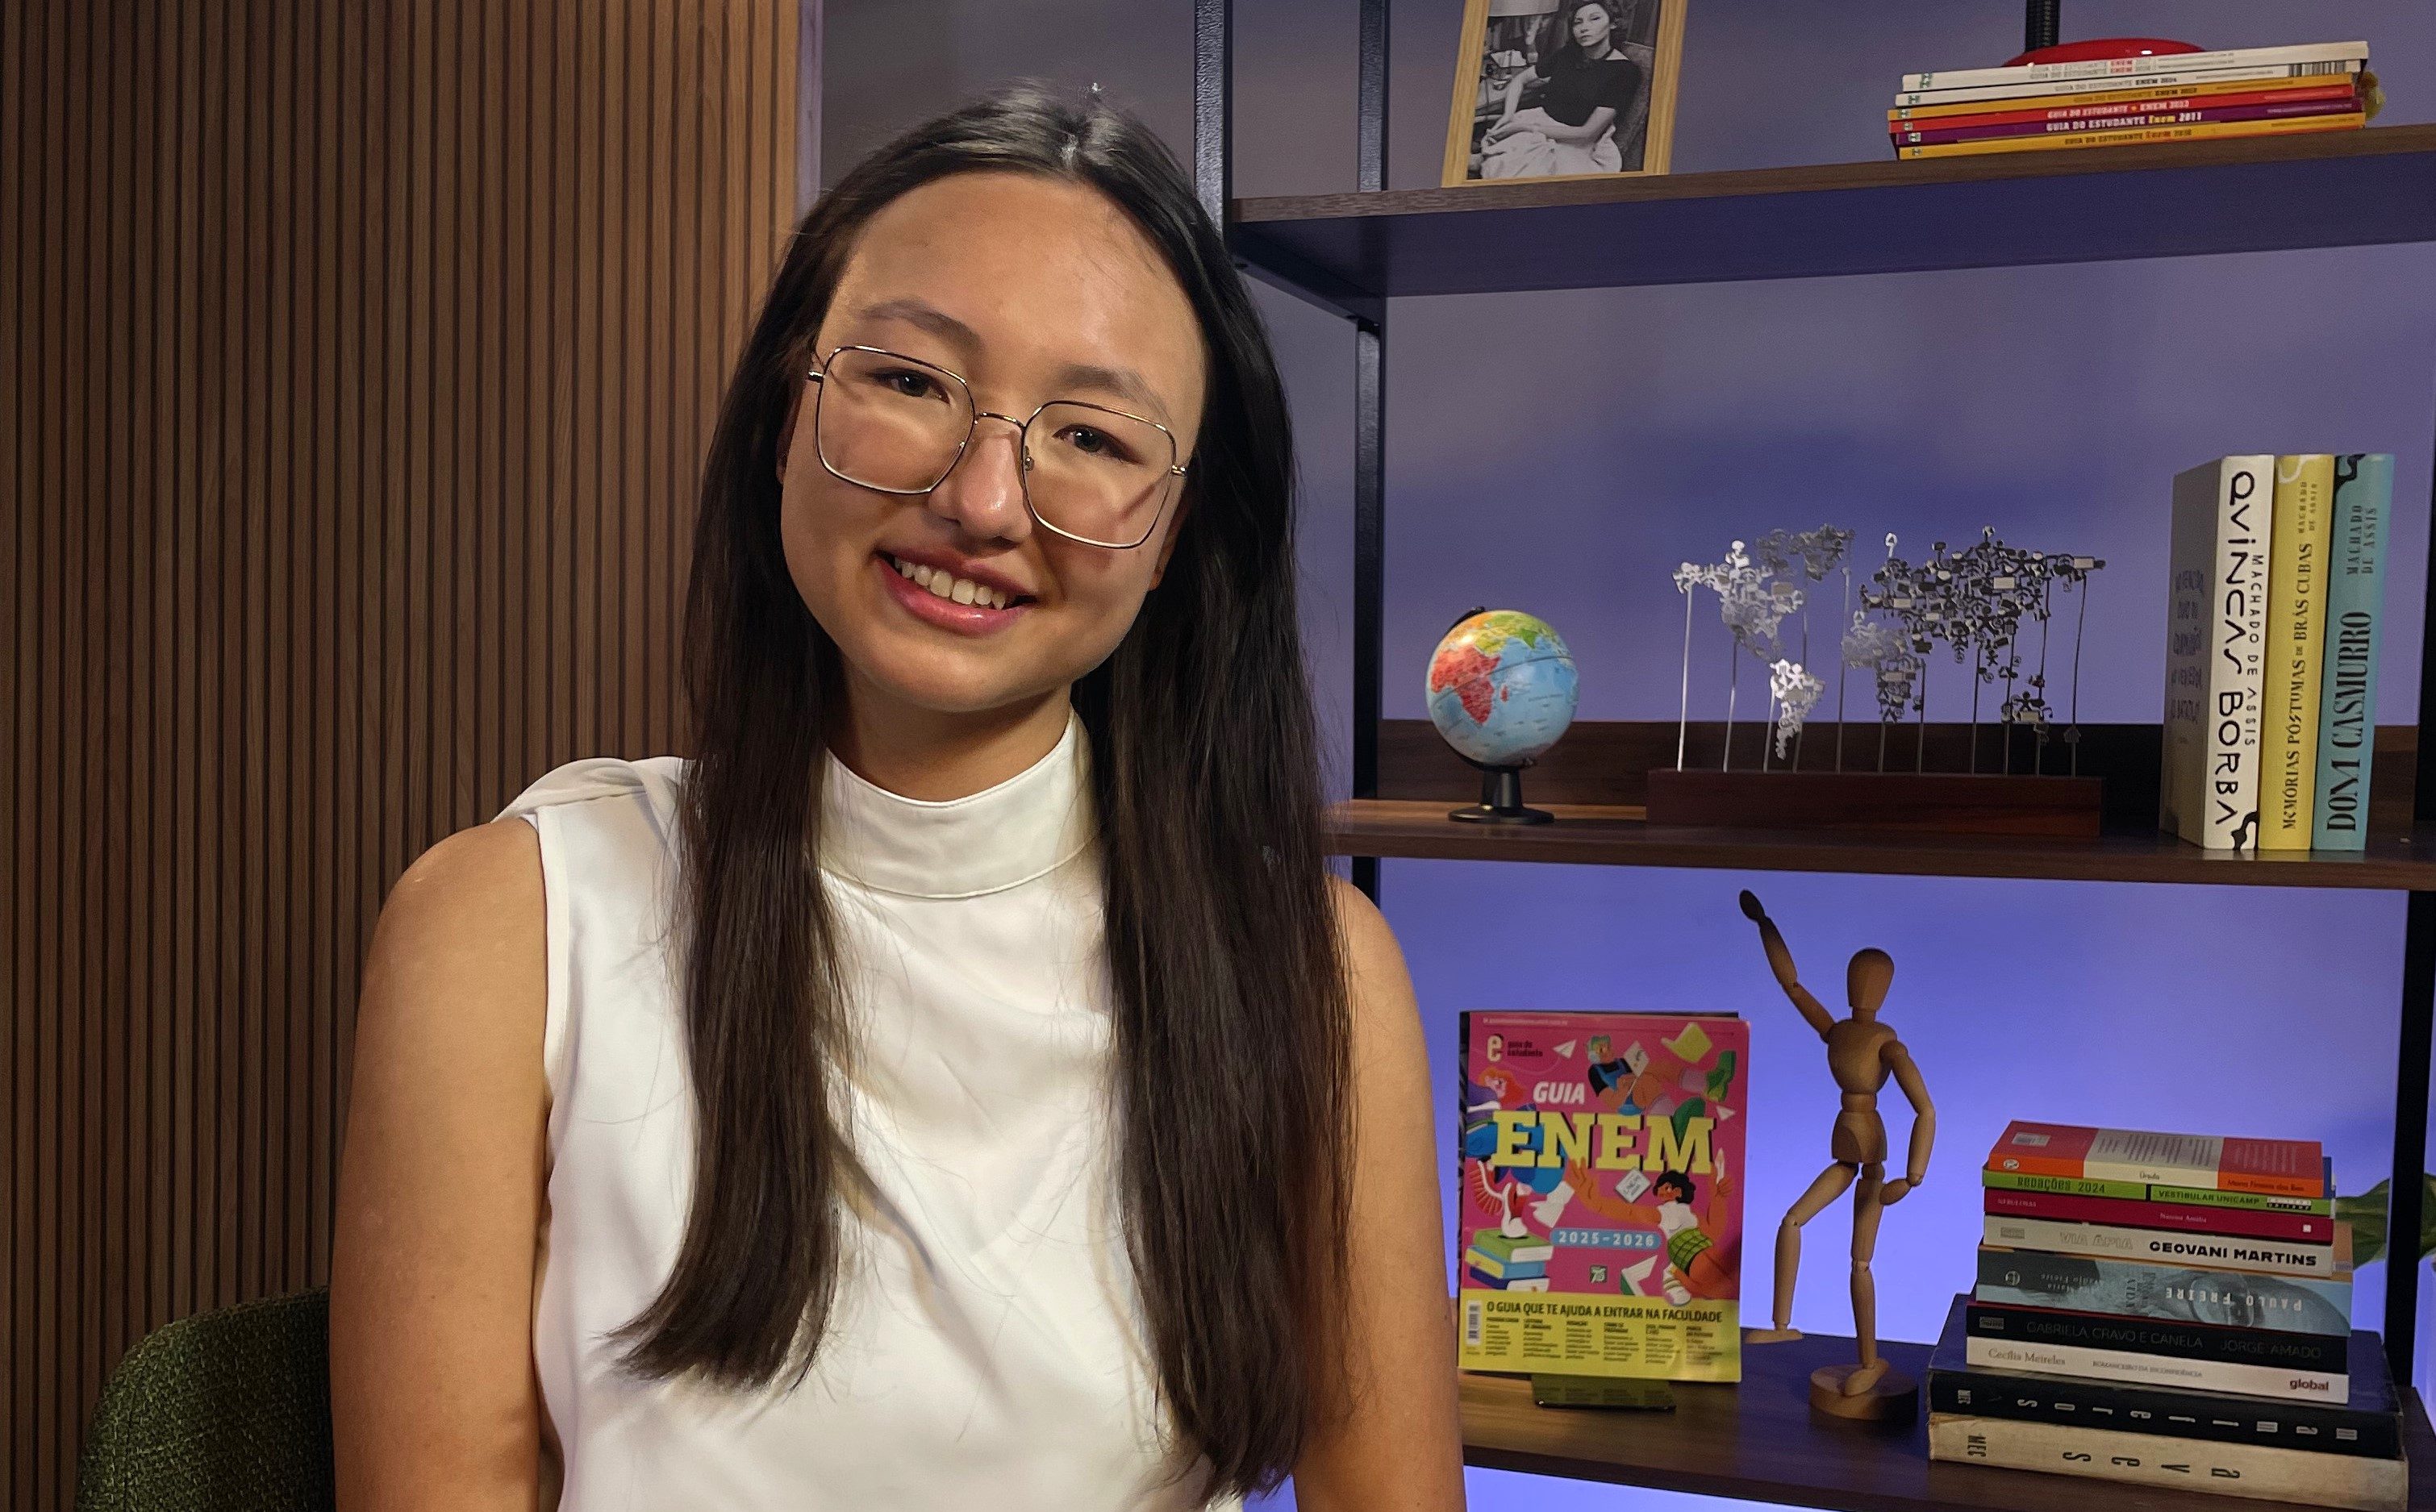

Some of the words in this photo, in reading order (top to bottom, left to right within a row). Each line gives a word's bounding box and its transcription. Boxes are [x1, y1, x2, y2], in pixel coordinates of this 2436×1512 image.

[2046, 123, 2070, 131] GUIA
[2072, 121, 2086, 129] DO
[2088, 116, 2146, 128] ESTUDANTE
[2346, 505, 2363, 576] MACHADO
[2363, 508, 2377, 549] ASSIS
[2296, 543, 2313, 594] CUBAS
[2361, 557, 2374, 574] DE
[2249, 554, 2264, 644] MACHADO
[2292, 599, 2310, 640] BRÁS
[2246, 654, 2259, 676] DE
[2331, 611, 2371, 748] CASMURRO
[2288, 660, 2305, 744] PÓSTUMAS
[2245, 687, 2257, 746] ASSIS
[2215, 691, 2244, 825] BORBA
[2282, 750, 2300, 831] MEMÓRIAS
[2327, 758, 2360, 831] DOM
[1533, 1081, 1585, 1104] GUIA
[1491, 1110, 1715, 1174] ENEM
[2078, 1181, 2105, 1193] 2024
[2159, 1189, 2214, 1202] VESTIBULAR
[2217, 1195, 2260, 1205] UNICAMP
[1559, 1231, 1654, 1248] 2025-2026
[2149, 1240, 2228, 1259] GEOVANI
[2234, 1248, 2317, 1267] MARTINS
[2165, 1286, 2231, 1306] FREIRE
[2246, 1294, 2302, 1312] PAULO
[1487, 1301, 1495, 1312] O
[1496, 1302, 1520, 1313] GUIA
[1523, 1302, 1544, 1316] QUE
[1546, 1304, 1558, 1314] TE
[1560, 1304, 1591, 1317] AJUDA
[1594, 1306, 1600, 1317] A
[1604, 1306, 1643, 1319] ENTRAR
[1646, 1309, 1659, 1320] NA
[1662, 1309, 1723, 1322] FACULDADE
[2026, 1320, 2090, 1339] GABRIELA
[2092, 1327, 2136, 1343] CRAVO
[2140, 1331, 2147, 1343] E
[2150, 1332, 2204, 1349] CANELA
[2025, 1351, 2066, 1366] Meireles
[2221, 1339, 2264, 1355] JORGE
[2270, 1345, 2321, 1360] AMADO
[2289, 1377, 2330, 1392] global
[1967, 1435, 1987, 1457] MEC
[2063, 1452, 2241, 1478] aves
